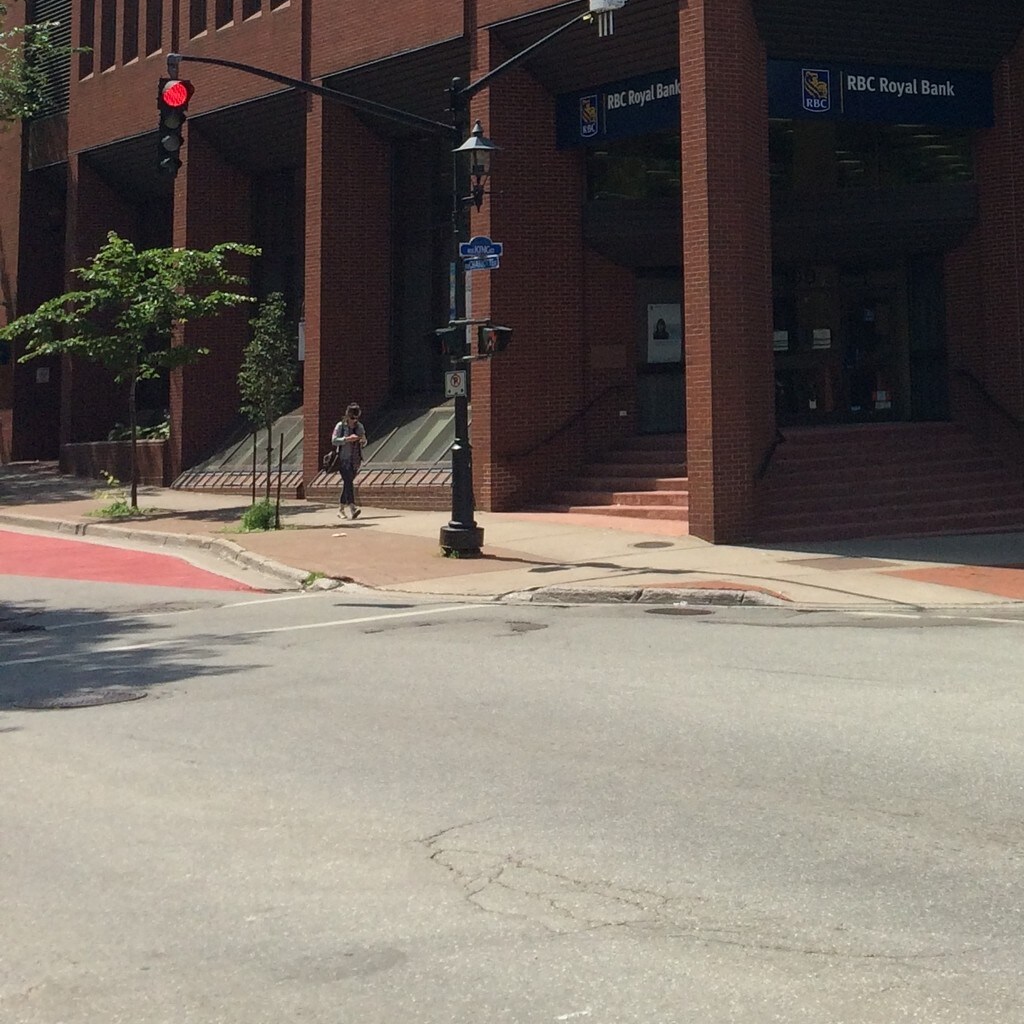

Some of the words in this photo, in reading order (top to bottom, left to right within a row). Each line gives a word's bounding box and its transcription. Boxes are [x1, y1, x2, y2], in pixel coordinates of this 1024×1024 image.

[847, 75, 876, 92] RBC
[880, 78, 918, 97] Royal
[921, 79, 955, 97] Bank
[607, 92, 627, 110] RBC
[628, 84, 655, 107] Royal
[656, 79, 681, 98] Bank
[806, 98, 828, 109] RBC
[583, 123, 596, 134] RBC
